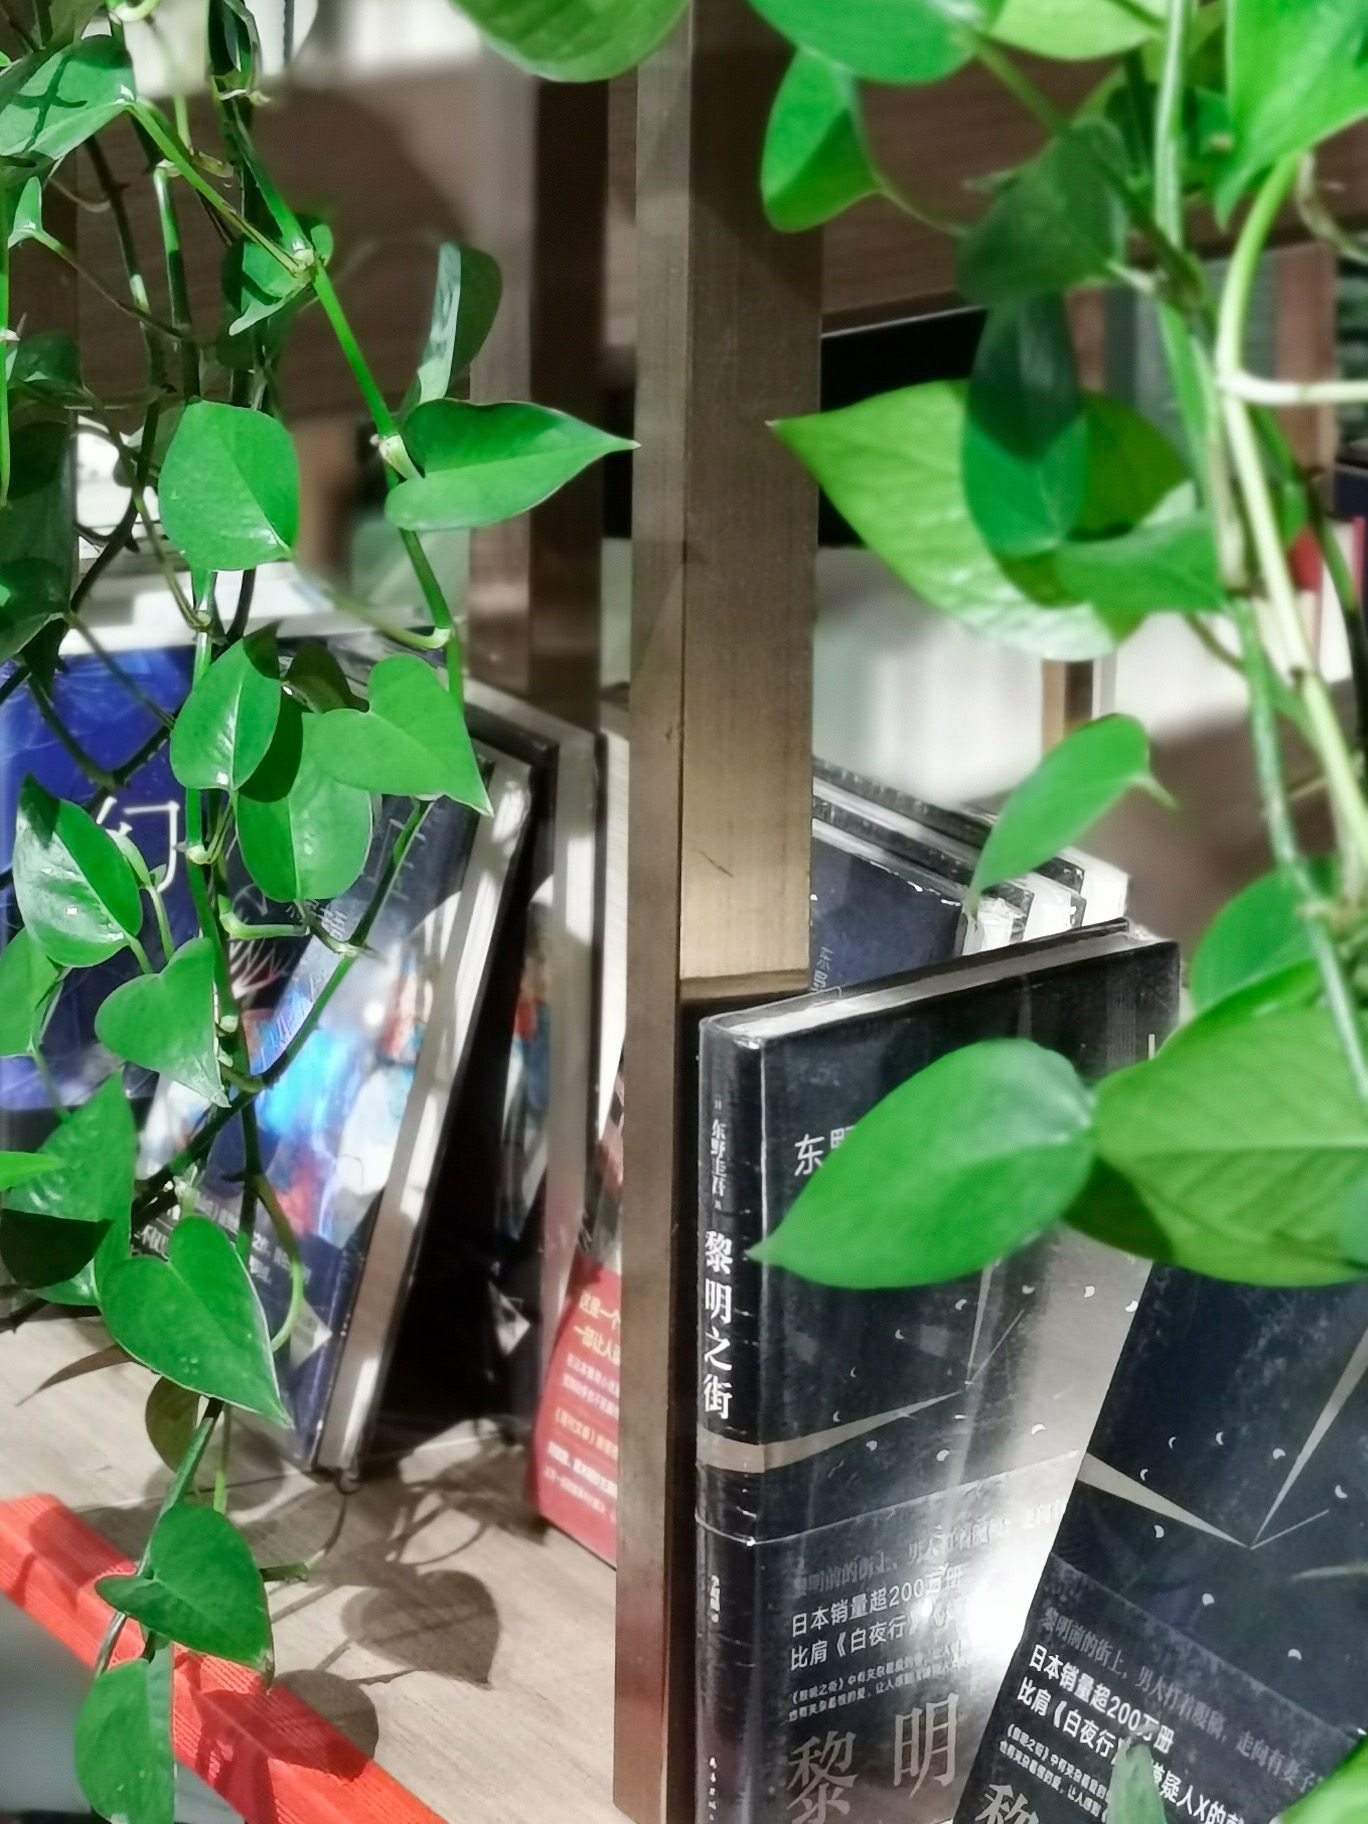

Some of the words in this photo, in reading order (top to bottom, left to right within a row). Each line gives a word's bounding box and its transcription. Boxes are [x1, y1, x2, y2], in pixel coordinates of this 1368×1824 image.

[794, 1124, 857, 1177] 东
[704, 1230, 733, 1420] 黎明之街
[1029, 1644, 1175, 1754] 日本销量超200万册
